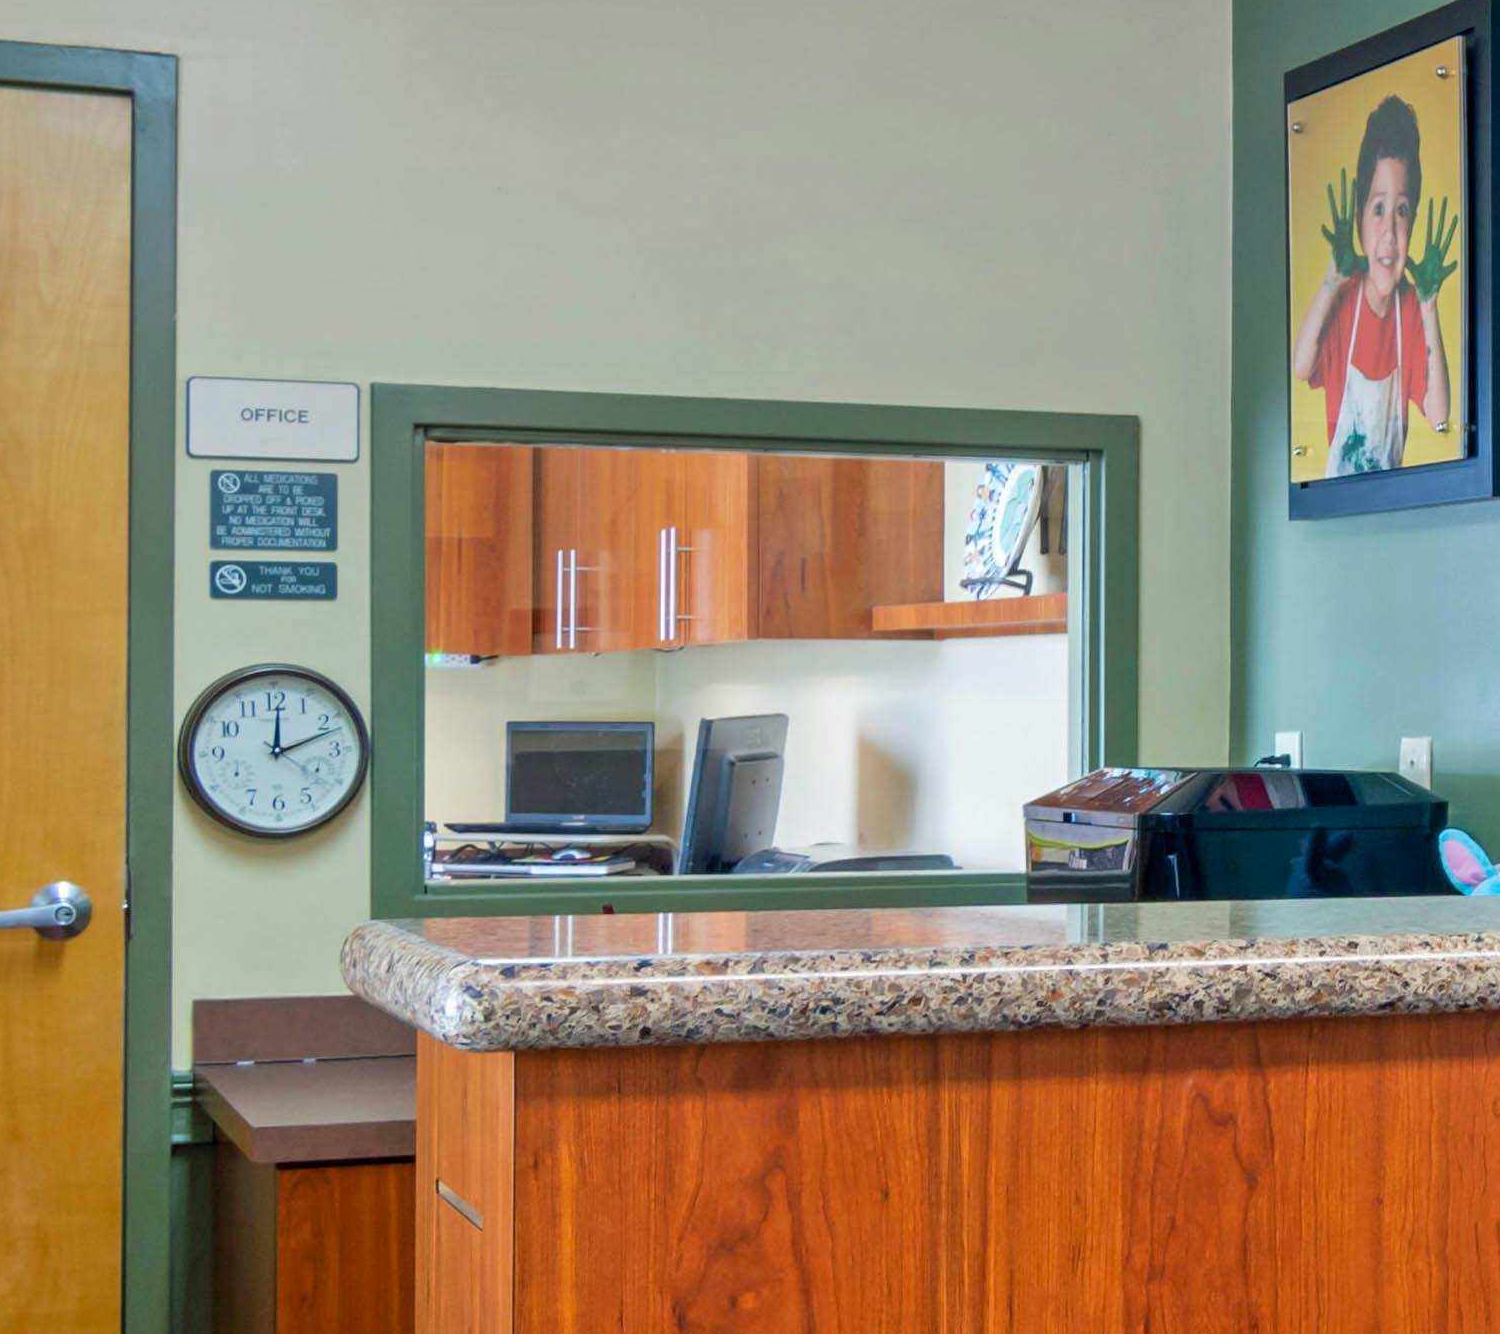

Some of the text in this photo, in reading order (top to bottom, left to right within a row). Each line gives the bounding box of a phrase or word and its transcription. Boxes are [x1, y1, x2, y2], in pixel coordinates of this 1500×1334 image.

[241, 408, 309, 423] OFFICE
[244, 474, 259, 483] ALL
[258, 485, 303, 495] ARE TO BE
[266, 495, 282, 504] OFF
[222, 505, 235, 514] UP
[237, 505, 248, 513] AT
[252, 506, 267, 515] THE
[271, 506, 298, 515] FRONT
[229, 516, 241, 524] NO
[245, 516, 294, 525] MEDICATION
[216, 526, 227, 535] BE
[294, 528, 330, 537] WITHOUT
[260, 566, 320, 576] THANK YOU
[252, 584, 326, 594] NOT SMOKING
[240, 700, 256, 717] 11
[266, 691, 286, 711] 12
[300, 698, 306, 715] 1
[222, 720, 239, 737] 10
[318, 715, 329, 730] 2
[212, 746, 225, 763] 9
[329, 741, 341, 757] 3
[246, 789, 257, 806] 7
[272, 794, 285, 811] 6
[301, 787, 312, 804] 5
